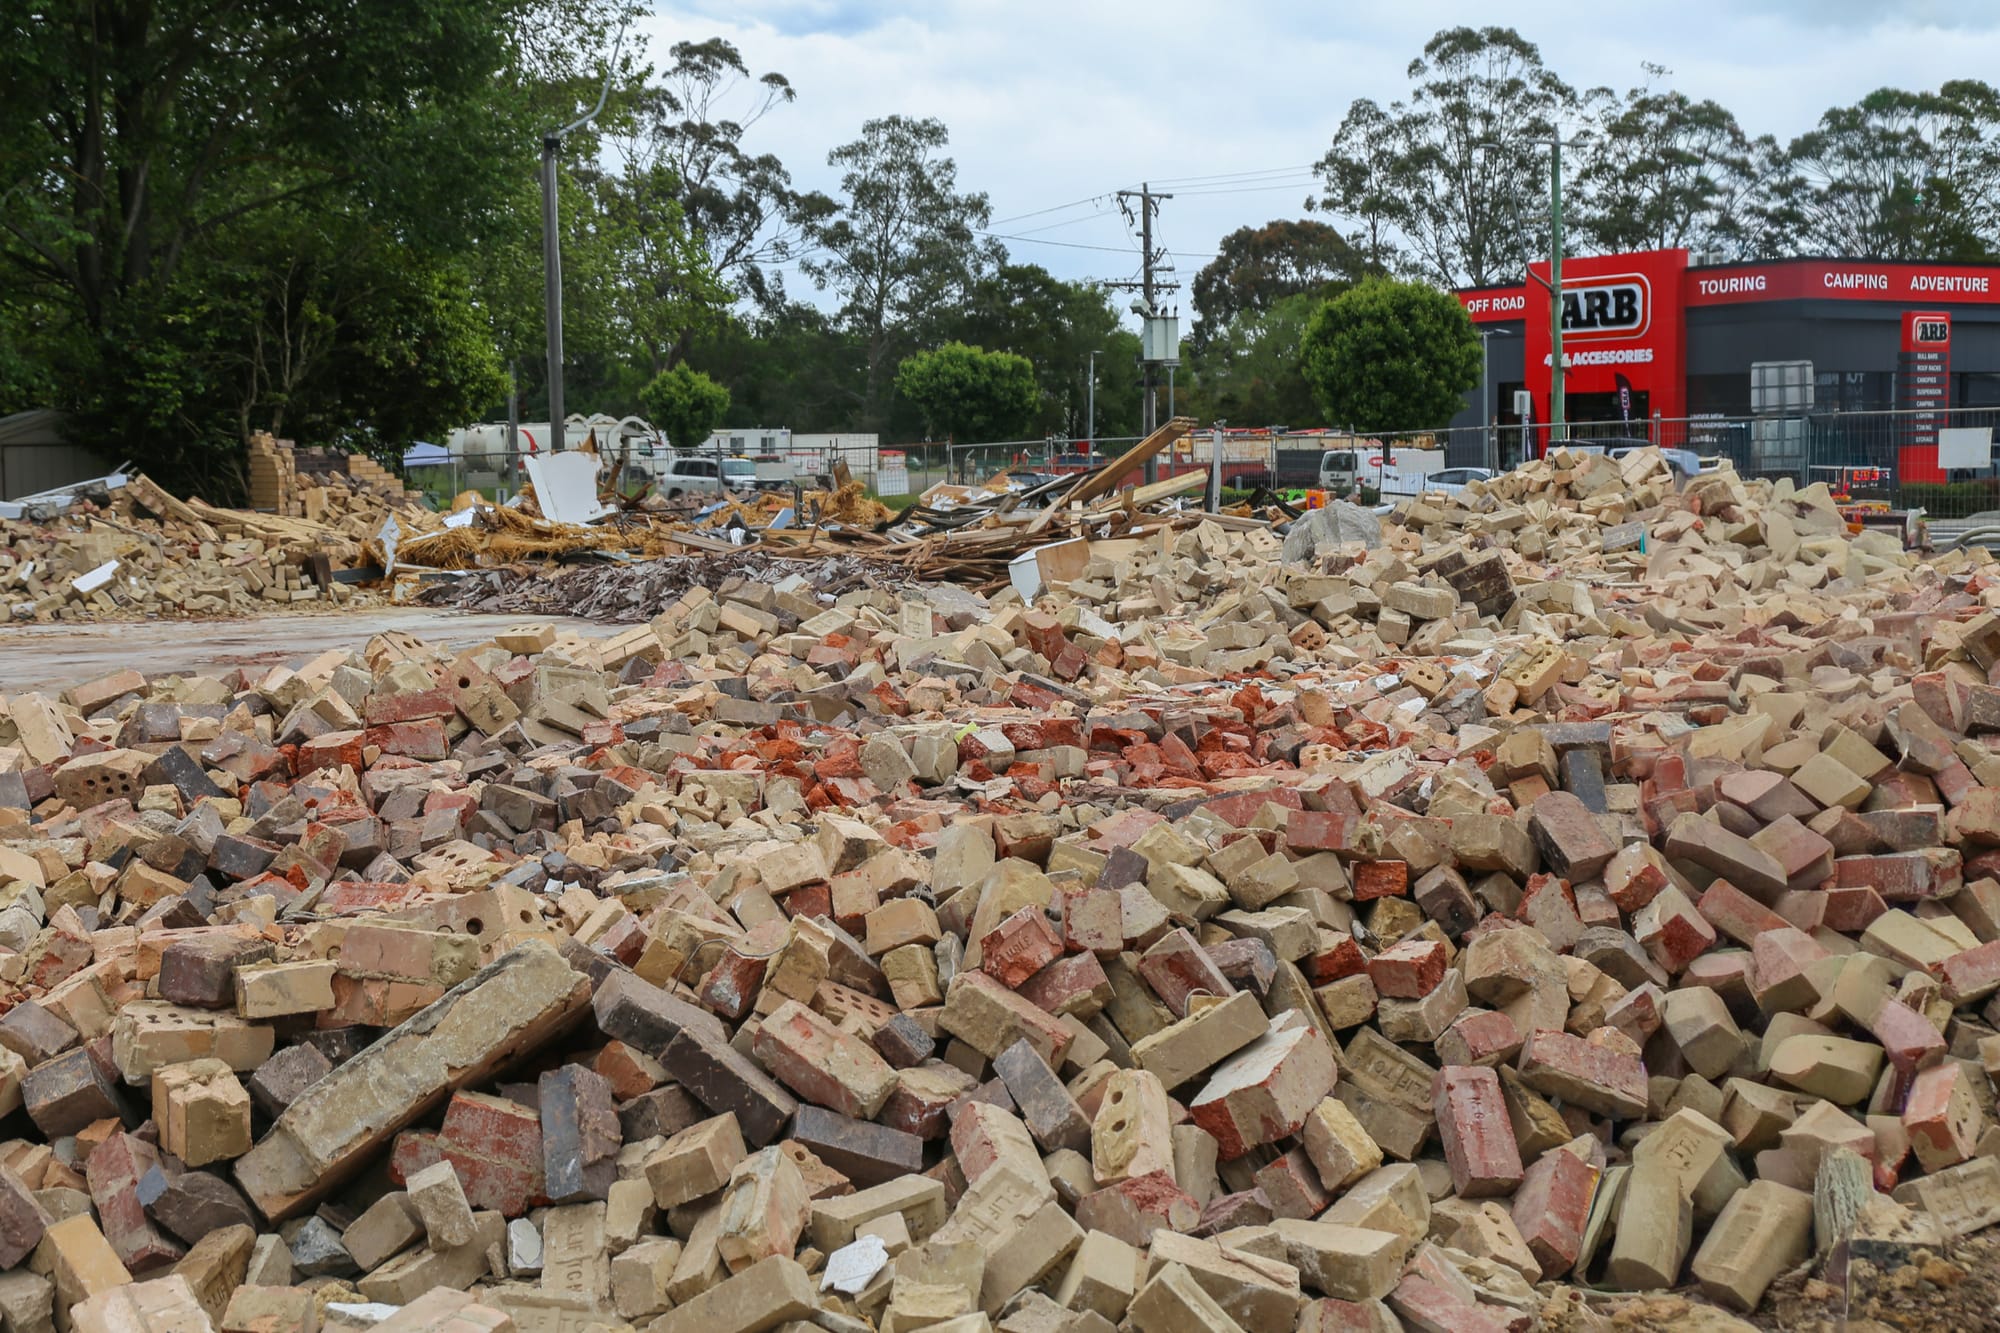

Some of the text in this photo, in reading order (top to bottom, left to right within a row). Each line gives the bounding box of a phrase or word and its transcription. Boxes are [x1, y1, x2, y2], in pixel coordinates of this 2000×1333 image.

[1699, 275, 1767, 296] TOURING
[1823, 271, 1889, 290] CAMPING
[1910, 274, 1990, 293] ADVENTURE
[1467, 295, 1526, 313] OFF ROAD
[1561, 287, 1639, 330] ARB
[1919, 322, 1948, 341] ARB
[1572, 347, 1654, 366] ACCESSORIES
